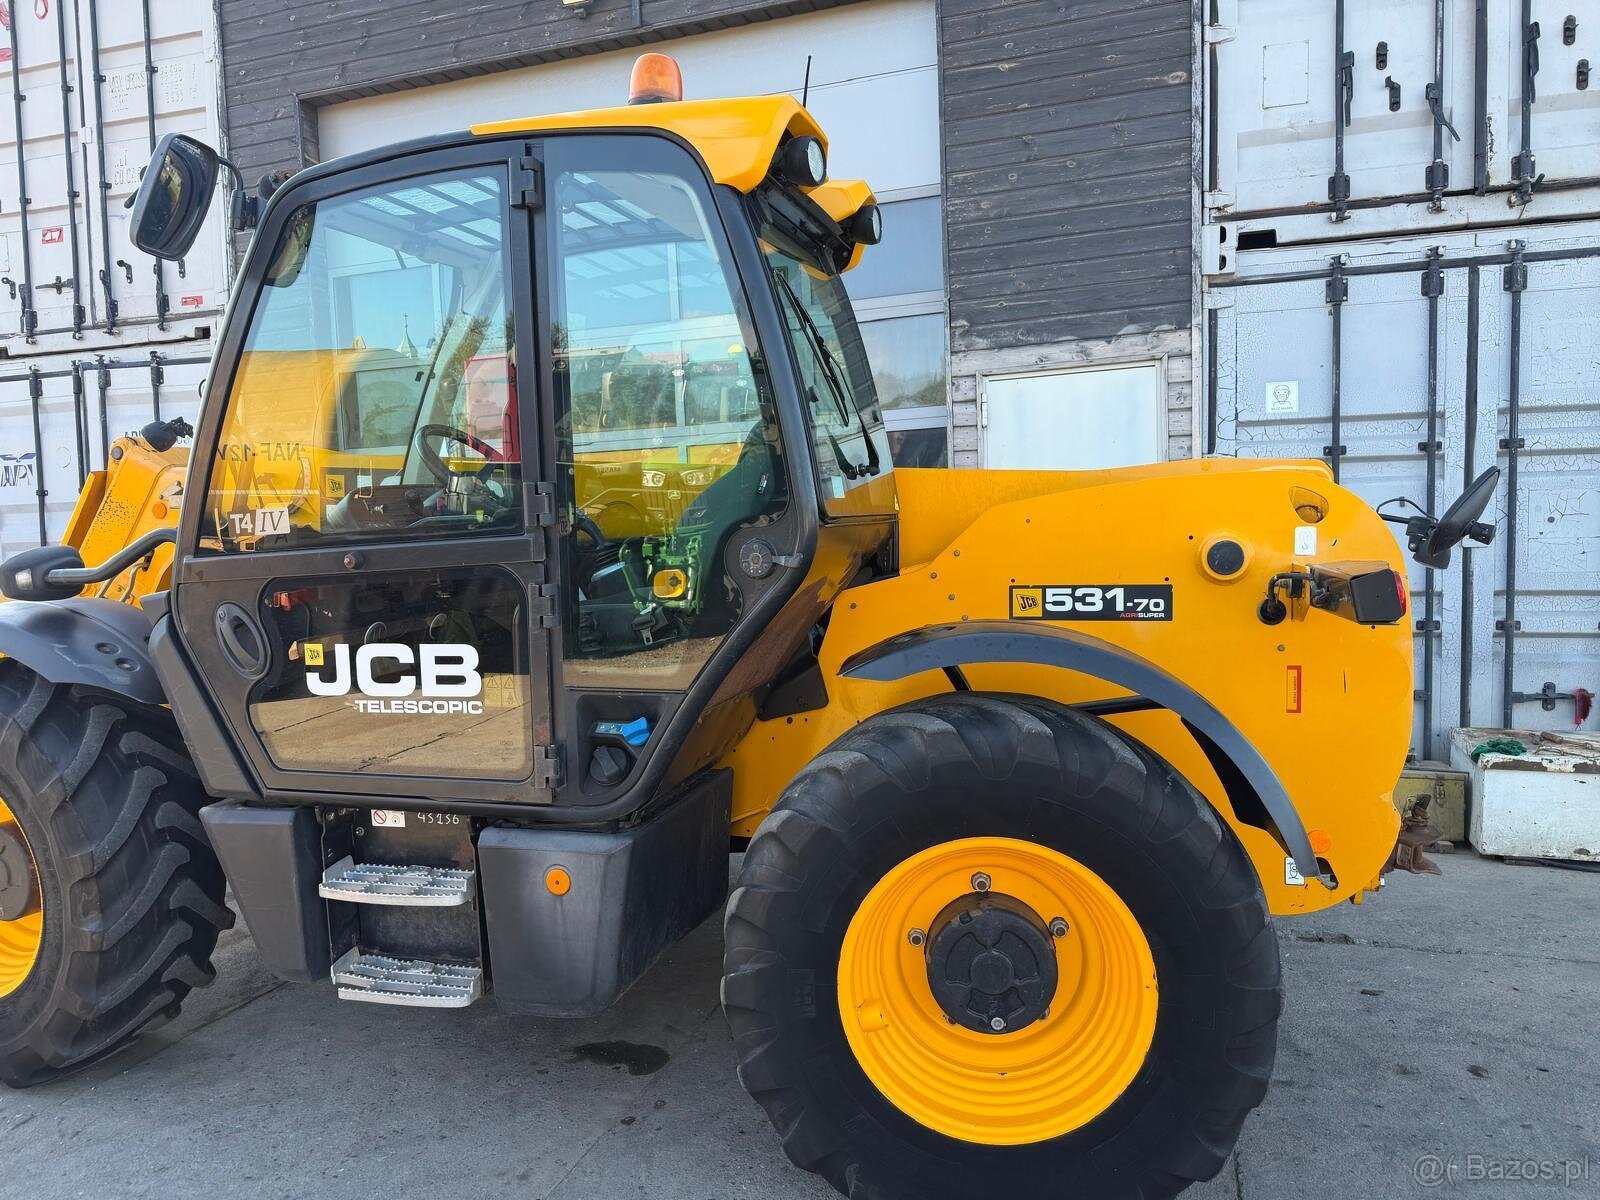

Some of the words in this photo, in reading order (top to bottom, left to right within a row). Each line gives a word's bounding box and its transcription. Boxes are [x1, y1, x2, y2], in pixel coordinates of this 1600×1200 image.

[230, 513, 254, 534] T4
[259, 510, 286, 533] IV
[1018, 595, 1038, 611] JCB
[305, 643, 482, 697] JCB
[354, 700, 483, 714] TELESCOPIC
